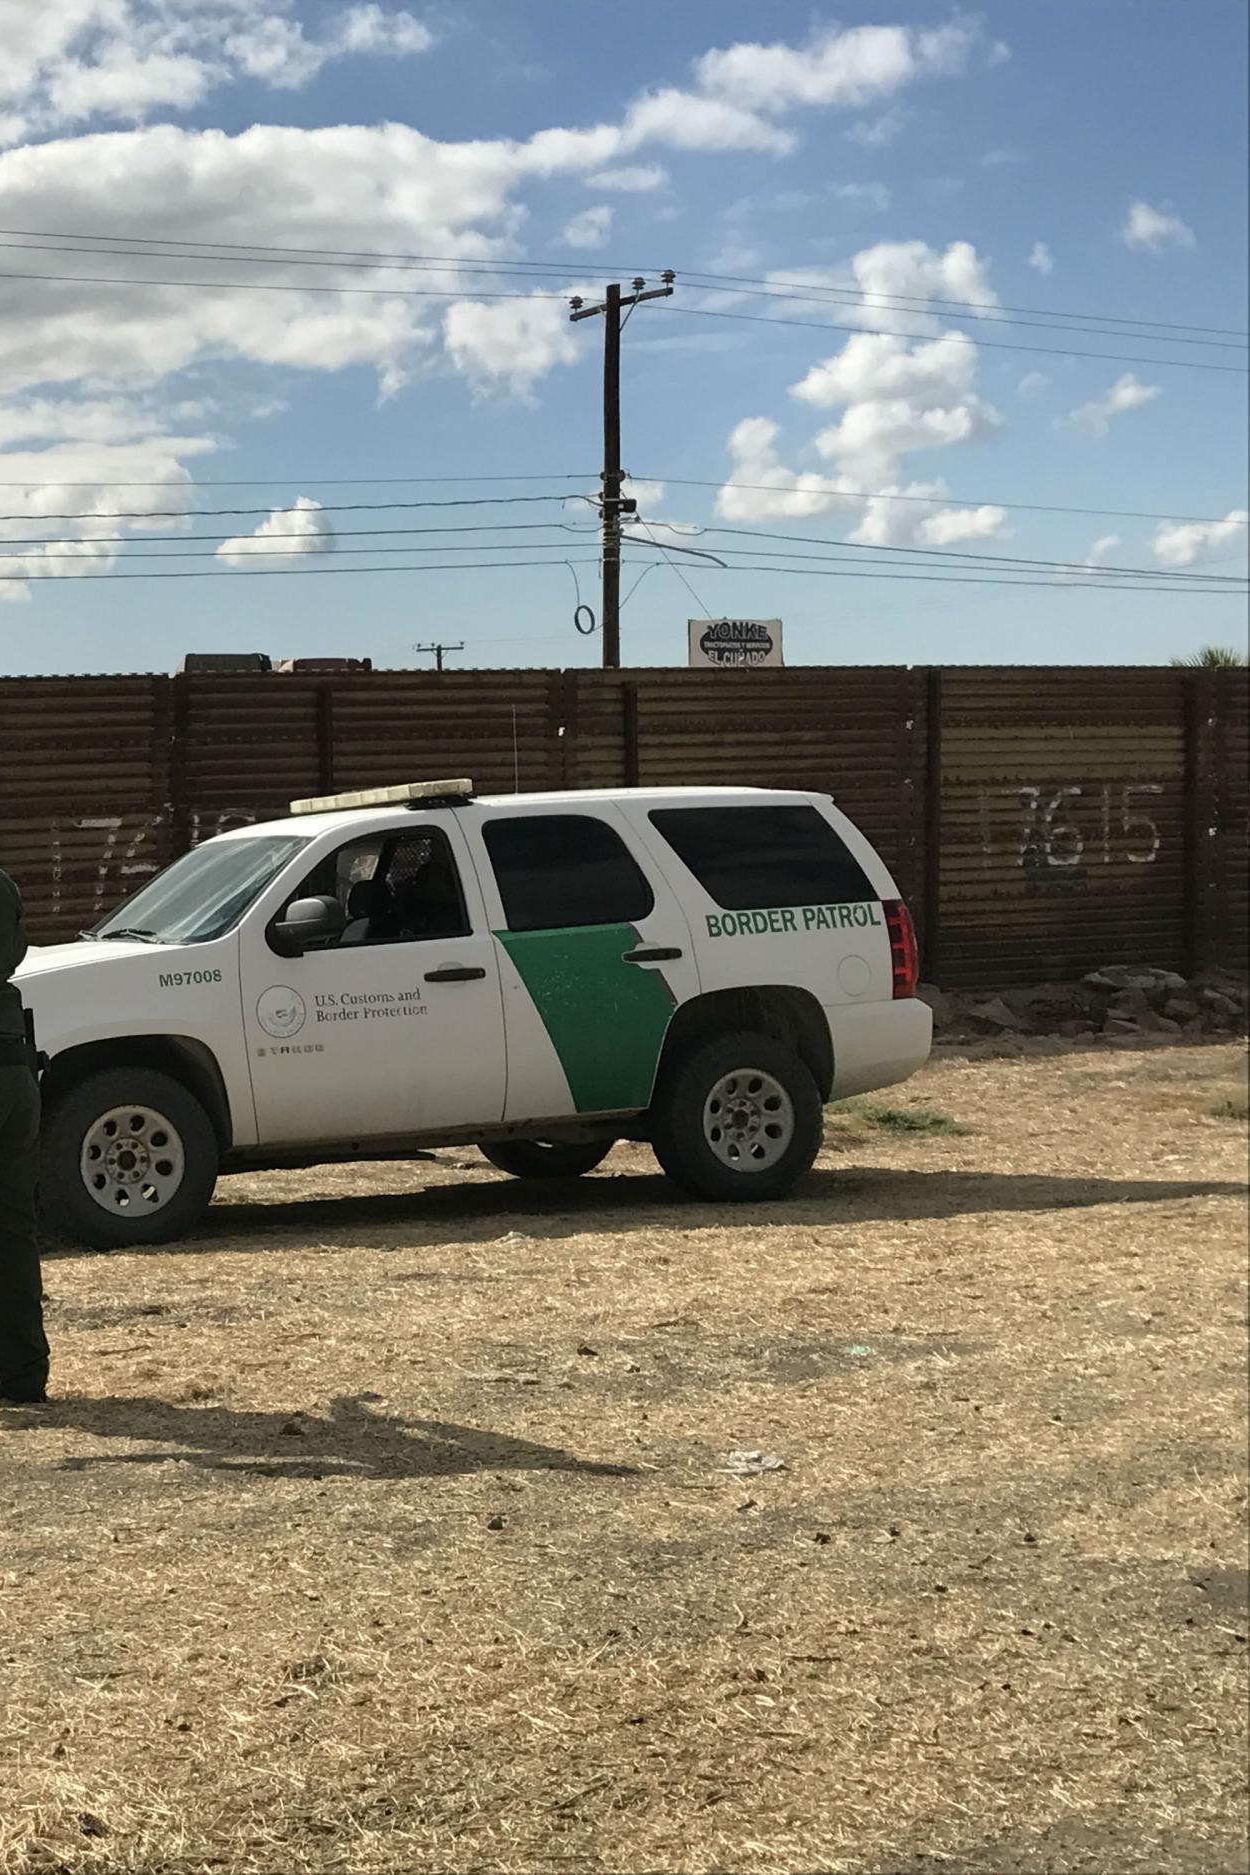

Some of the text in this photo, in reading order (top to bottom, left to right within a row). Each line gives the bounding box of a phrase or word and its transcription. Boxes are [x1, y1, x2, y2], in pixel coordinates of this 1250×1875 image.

[707, 622, 767, 640] YONKE
[708, 650, 721, 666] EL
[705, 903, 881, 938] BORDER PATROL
[158, 969, 223, 988] M97008
[314, 987, 422, 1007] U.S. Customs and
[316, 1005, 428, 1022] Border Protection
